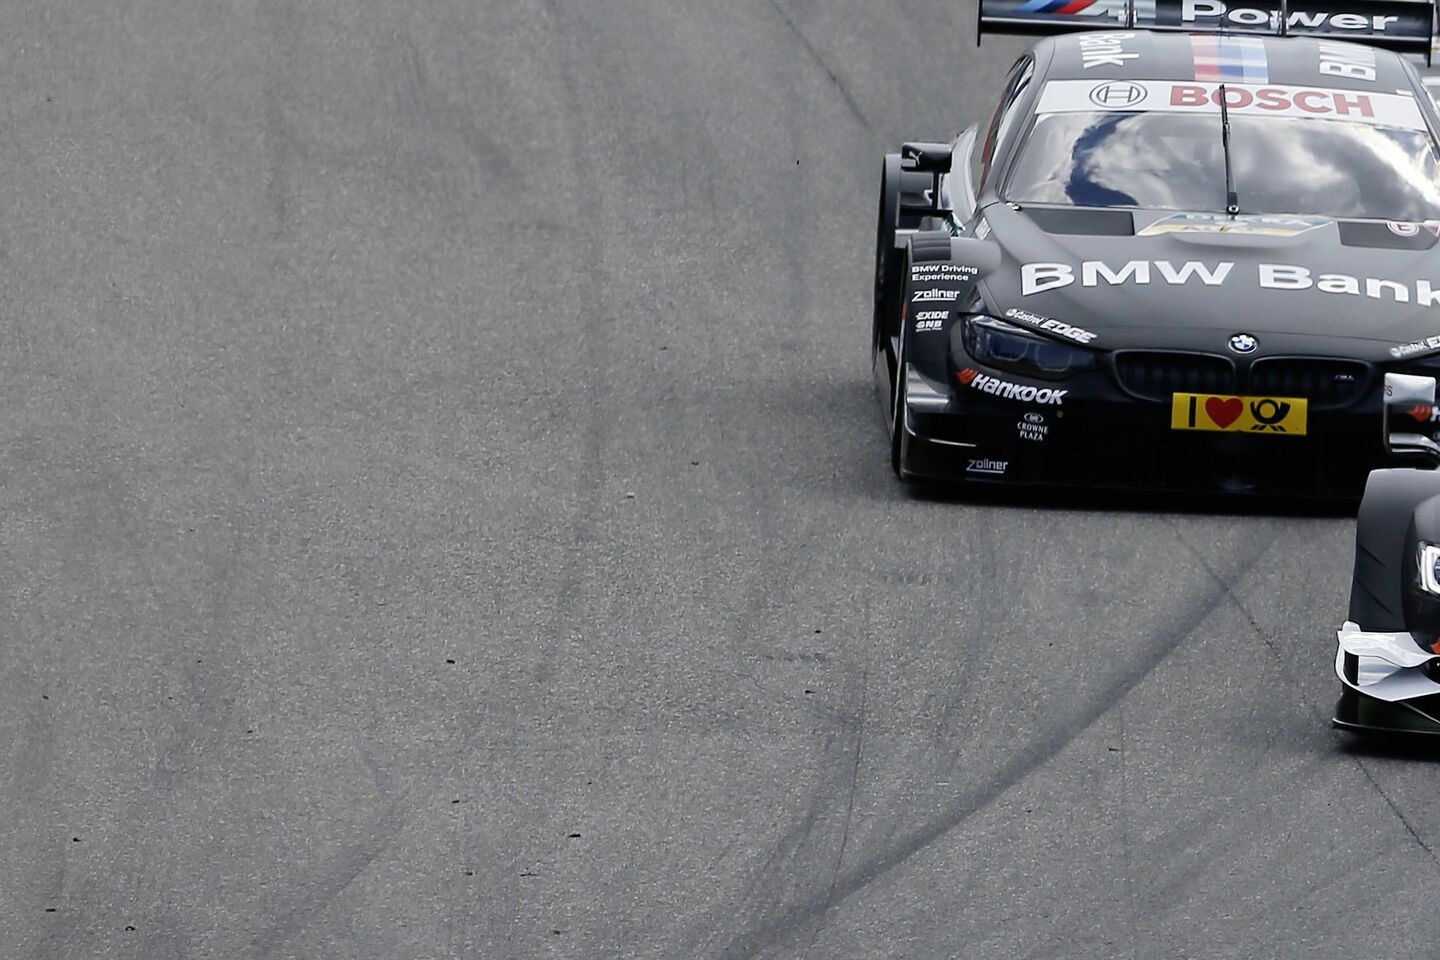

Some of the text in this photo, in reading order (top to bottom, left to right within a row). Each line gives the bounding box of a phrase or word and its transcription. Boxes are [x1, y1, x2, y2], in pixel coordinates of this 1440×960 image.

[1168, 85, 1376, 119] BOSCH
[911, 264, 978, 275] BMW Driving
[911, 273, 970, 282] Experience
[1021, 260, 1235, 297] BMW
[915, 310, 950, 321] EXIDE
[1039, 319, 1098, 344] EDGE
[1188, 396, 1197, 428] I
[1016, 421, 1049, 435] CROWNE
[1019, 430, 1044, 442] PLAZA
